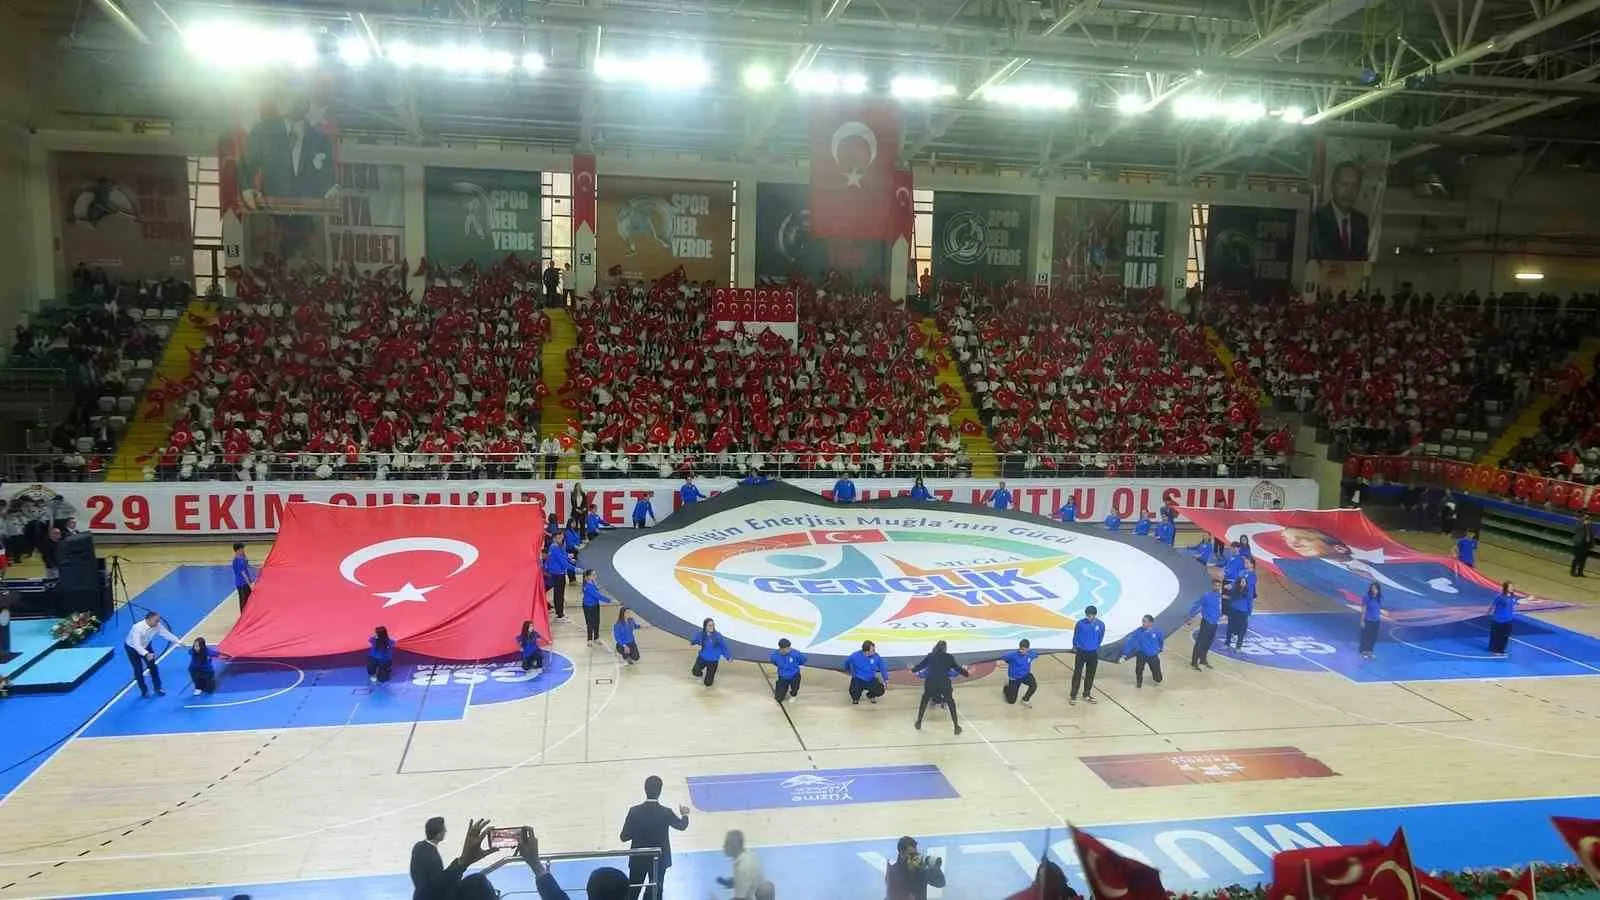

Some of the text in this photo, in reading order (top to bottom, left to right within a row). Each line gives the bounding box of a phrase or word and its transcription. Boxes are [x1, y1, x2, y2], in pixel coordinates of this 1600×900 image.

[490, 190, 529, 210] SPOR
[671, 193, 710, 216] SPOR
[491, 231, 537, 251] YERDE
[671, 237, 714, 259] YERDE
[86, 494, 151, 531] 29
[744, 514, 846, 530] Enerjisi
[857, 515, 999, 533] Muğla'nın
[753, 568, 1043, 597] GENÇLİK
[945, 585, 1060, 605] YILI
[888, 620, 977, 629] 2026
